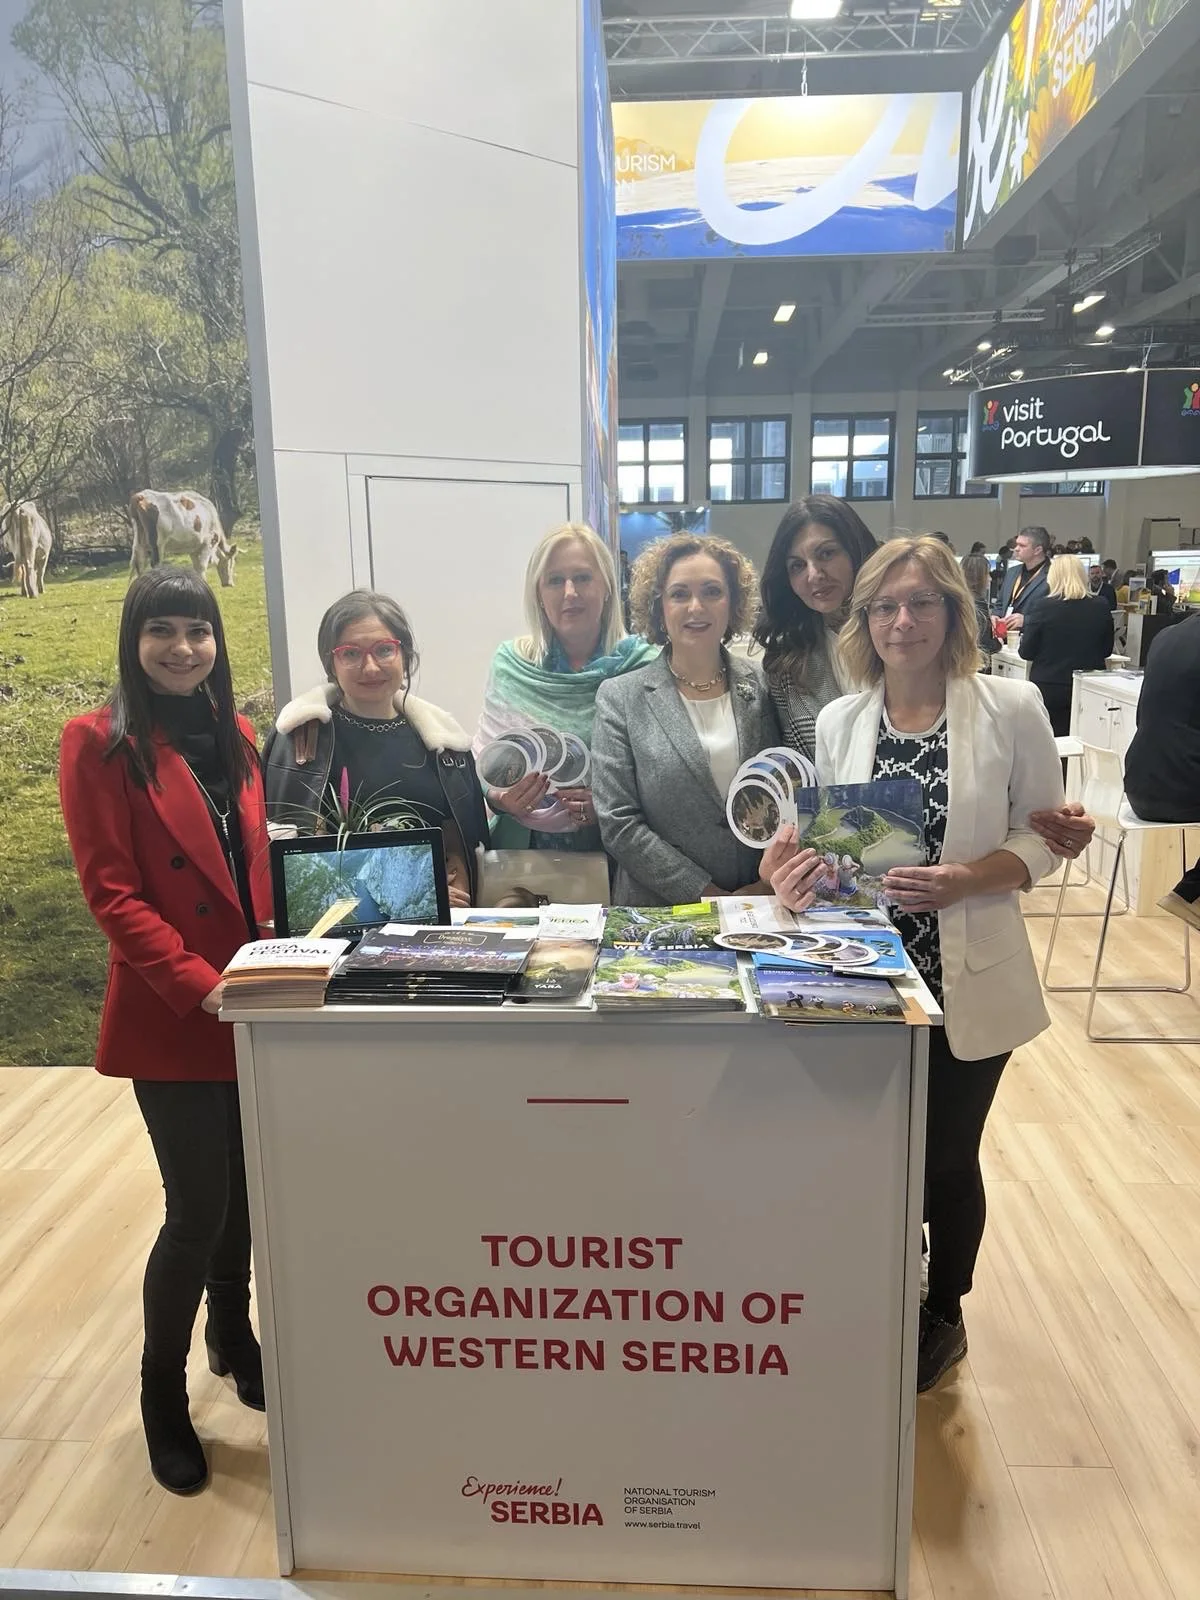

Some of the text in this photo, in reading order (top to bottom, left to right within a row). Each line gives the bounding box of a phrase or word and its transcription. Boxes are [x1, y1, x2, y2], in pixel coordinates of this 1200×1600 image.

[615, 153, 676, 173] URISM
[1003, 397, 1044, 422] visit
[481, 1235, 683, 1270] TOURIST
[367, 1285, 805, 1325] ORGANIZATION OF
[384, 1335, 789, 1376] WESTERN SERBIA
[461, 1476, 563, 1504] Experience!
[624, 1487, 716, 1497] NATIONAL TOURISM
[624, 1497, 696, 1506] ORGANISATION
[490, 1500, 603, 1526] SERBIA
[624, 1506, 673, 1515] OF SERBIA
[624, 1520, 701, 1530] www.serbia.travel
